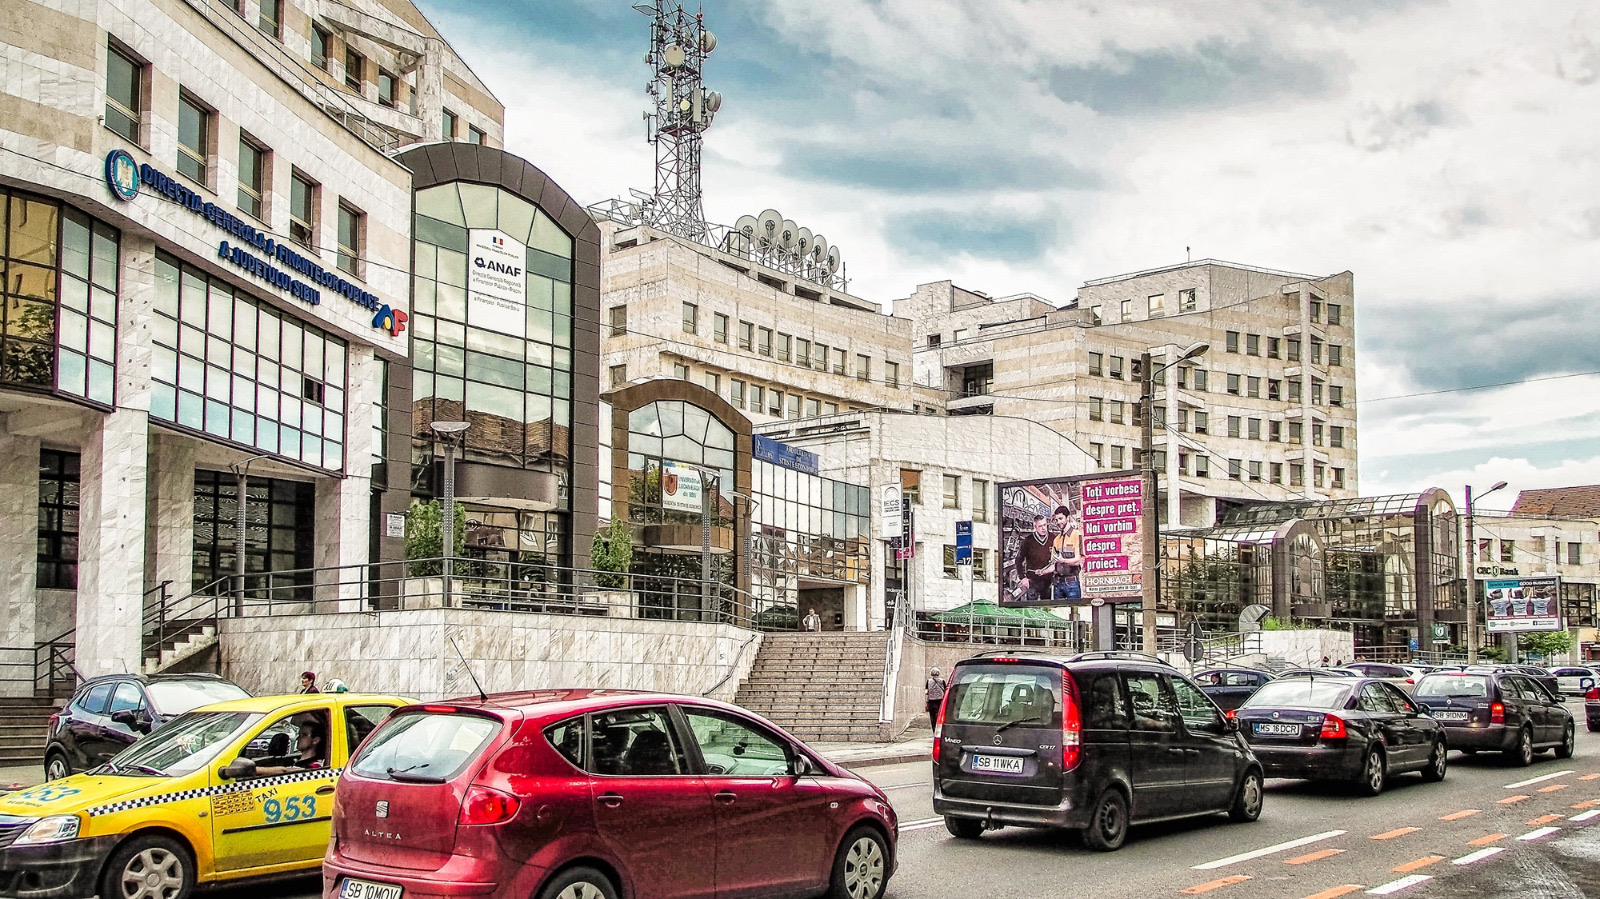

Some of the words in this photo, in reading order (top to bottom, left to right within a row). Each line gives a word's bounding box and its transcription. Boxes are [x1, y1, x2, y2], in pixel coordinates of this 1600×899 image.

[140, 163, 205, 213] DIRECTIA
[204, 202, 266, 250] GENERALA
[266, 238, 276, 256] A
[276, 243, 339, 292] FINANTELOR
[338, 279, 379, 311] PUBLICE
[218, 241, 231, 258] A
[231, 247, 292, 291] JUDETULUI
[291, 280, 320, 305] SIBIU
[1086, 486, 1102, 500] Toți
[1105, 484, 1139, 496] vorbesc
[1086, 505, 1115, 518] despre
[1117, 502, 1139, 515] preț.
[1086, 523, 1100, 534] Noi
[1104, 520, 1133, 532] vorbim
[1086, 541, 1116, 554] despre
[1086, 558, 1122, 572] proiect.
[1500, 567, 1519, 576] Bank
[1086, 575, 1131, 585] HORNBACH
[1260, 724, 1270, 732] MS
[978, 757, 991, 767] SB
[255, 787, 278, 803] TAXI
[264, 794, 316, 823] 953
[364, 829, 402, 841] ALTEA
[347, 882, 363, 898] SB
